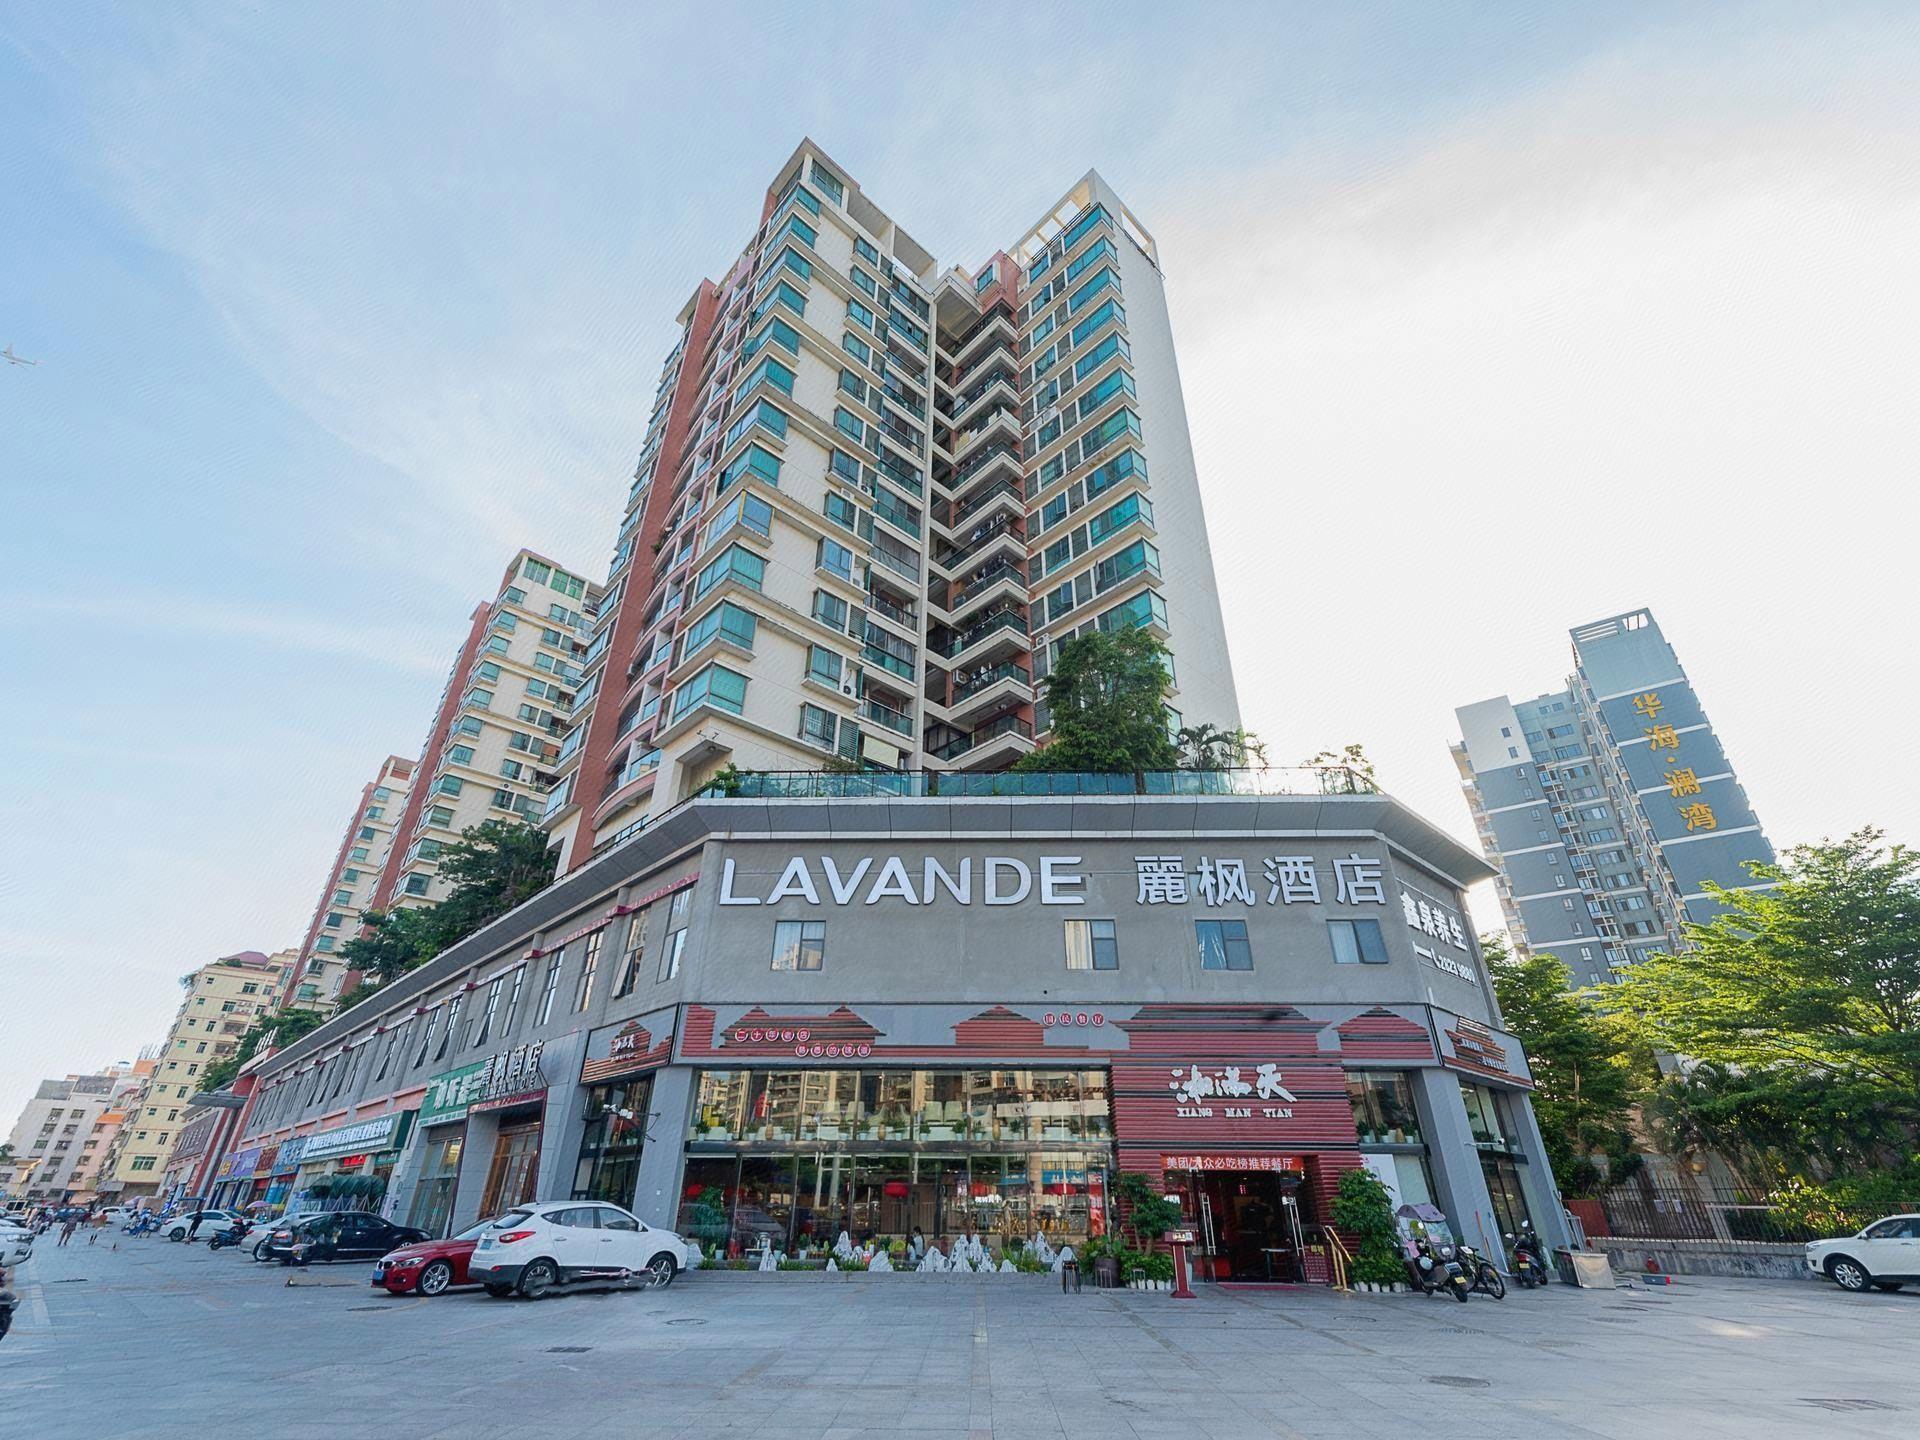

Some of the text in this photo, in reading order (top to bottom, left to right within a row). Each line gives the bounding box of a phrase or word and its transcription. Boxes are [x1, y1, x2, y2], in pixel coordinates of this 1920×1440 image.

[1632, 693, 1718, 831] 华海·澜湾
[719, 856, 1085, 906] LAVANDE
[1135, 853, 1387, 907] 麗枫酒店
[1176, 1107, 1293, 1118] XIANG MAN TIAN
